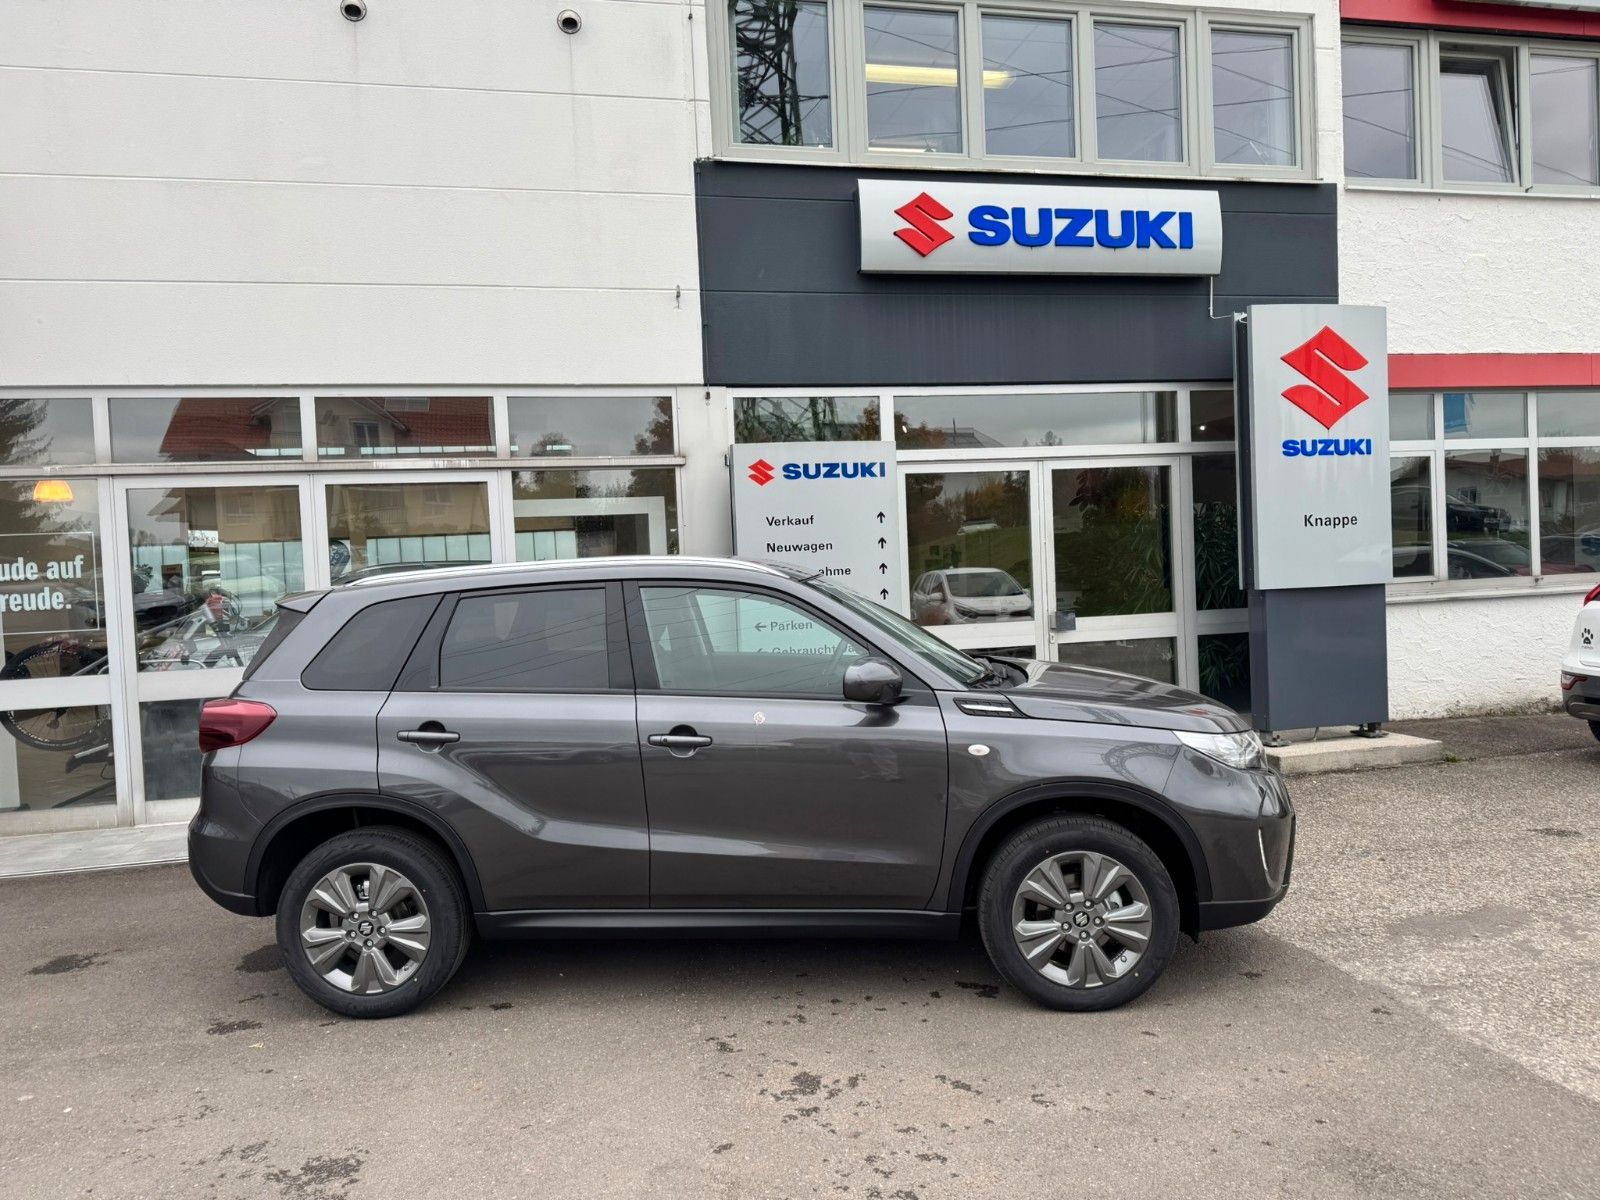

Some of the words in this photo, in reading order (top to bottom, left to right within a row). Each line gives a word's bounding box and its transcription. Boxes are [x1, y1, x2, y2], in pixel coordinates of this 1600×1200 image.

[968, 205, 1195, 249] SUZUKI
[1281, 438, 1373, 457] SUZUKI
[783, 462, 886, 480] SUZUKI
[766, 514, 815, 527] Verkauf
[1303, 513, 1358, 529] Knappe
[766, 541, 833, 554] Neuwagen
[46, 554, 84, 580] auf
[770, 619, 813, 631] Parken
